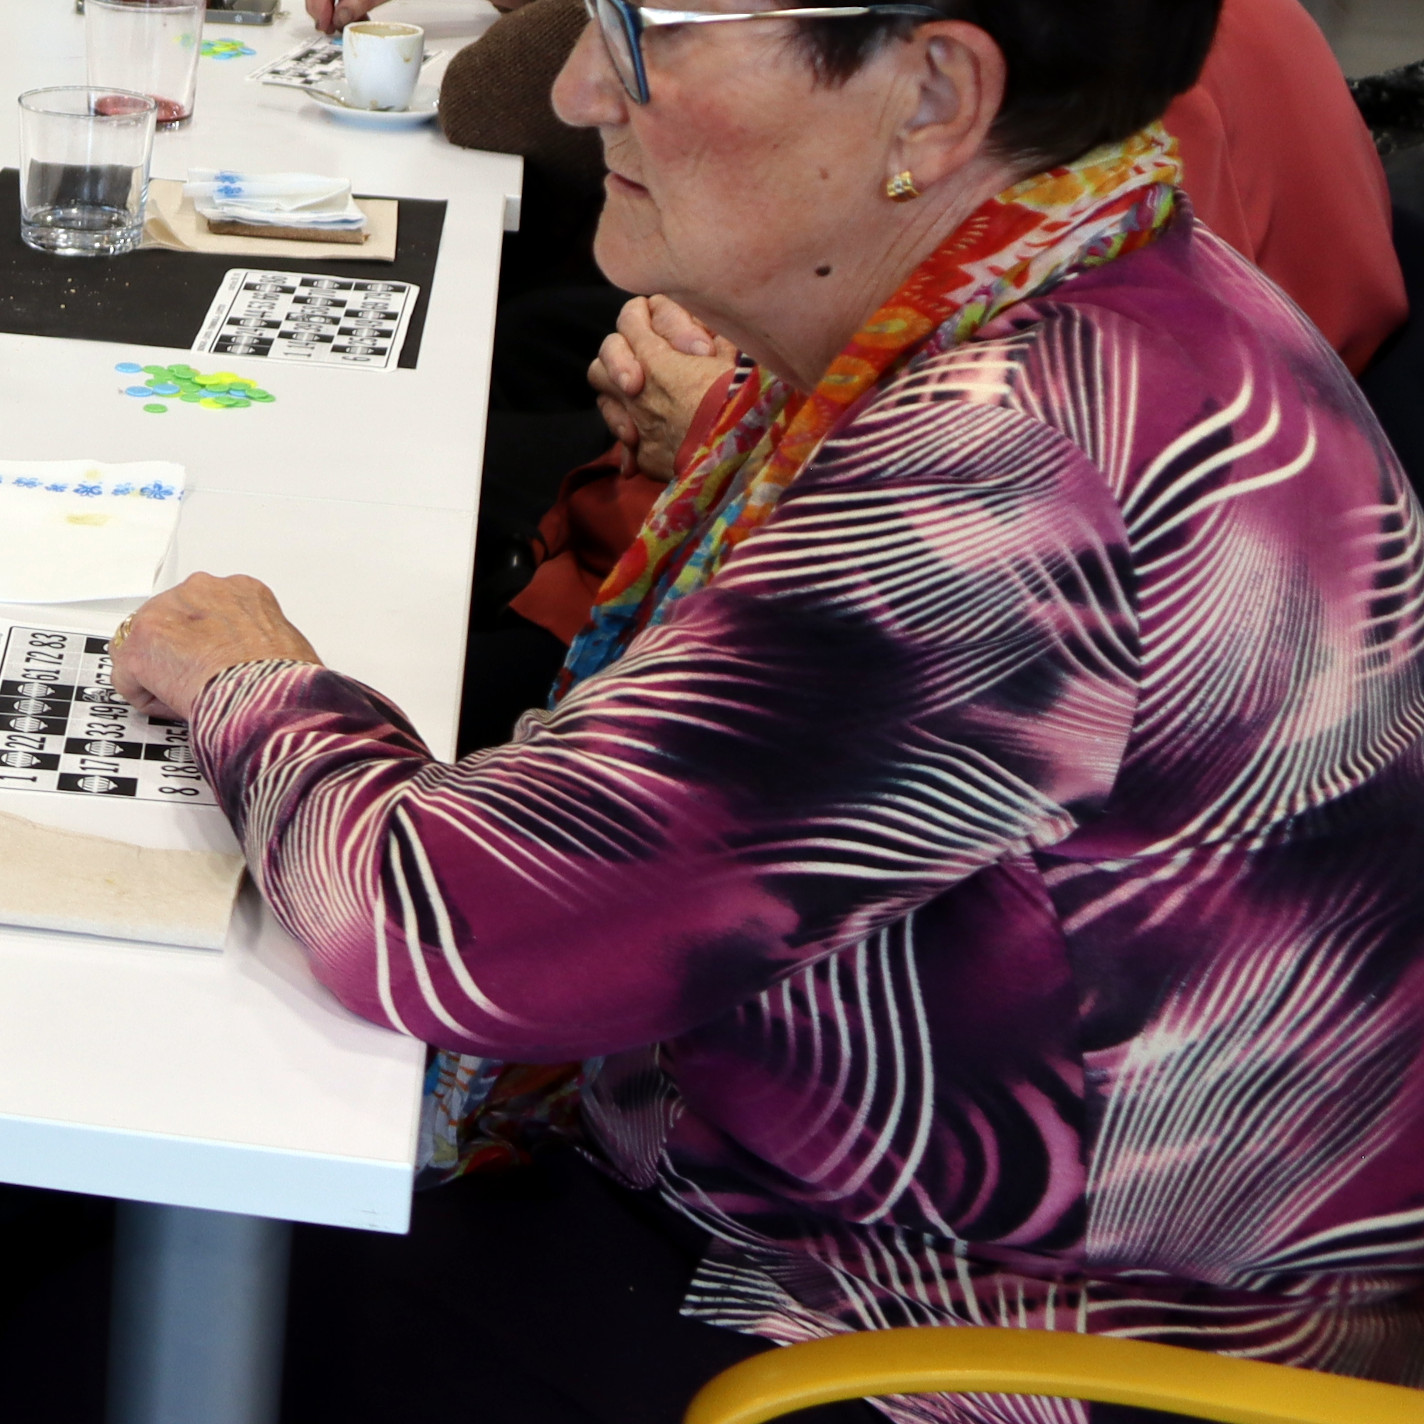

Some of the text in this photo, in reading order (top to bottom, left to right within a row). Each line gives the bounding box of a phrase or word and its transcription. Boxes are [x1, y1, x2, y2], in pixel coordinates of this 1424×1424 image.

[28, 632, 68, 649] 83
[24, 651, 65, 665] 72
[21, 668, 61, 682] 61
[89, 705, 129, 720] 49
[85, 722, 127, 739] 33
[5, 734, 47, 751] 22
[79, 758, 120, 774] 17
[161, 764, 202, 781] 18
[158, 786, 200, 796] 8
